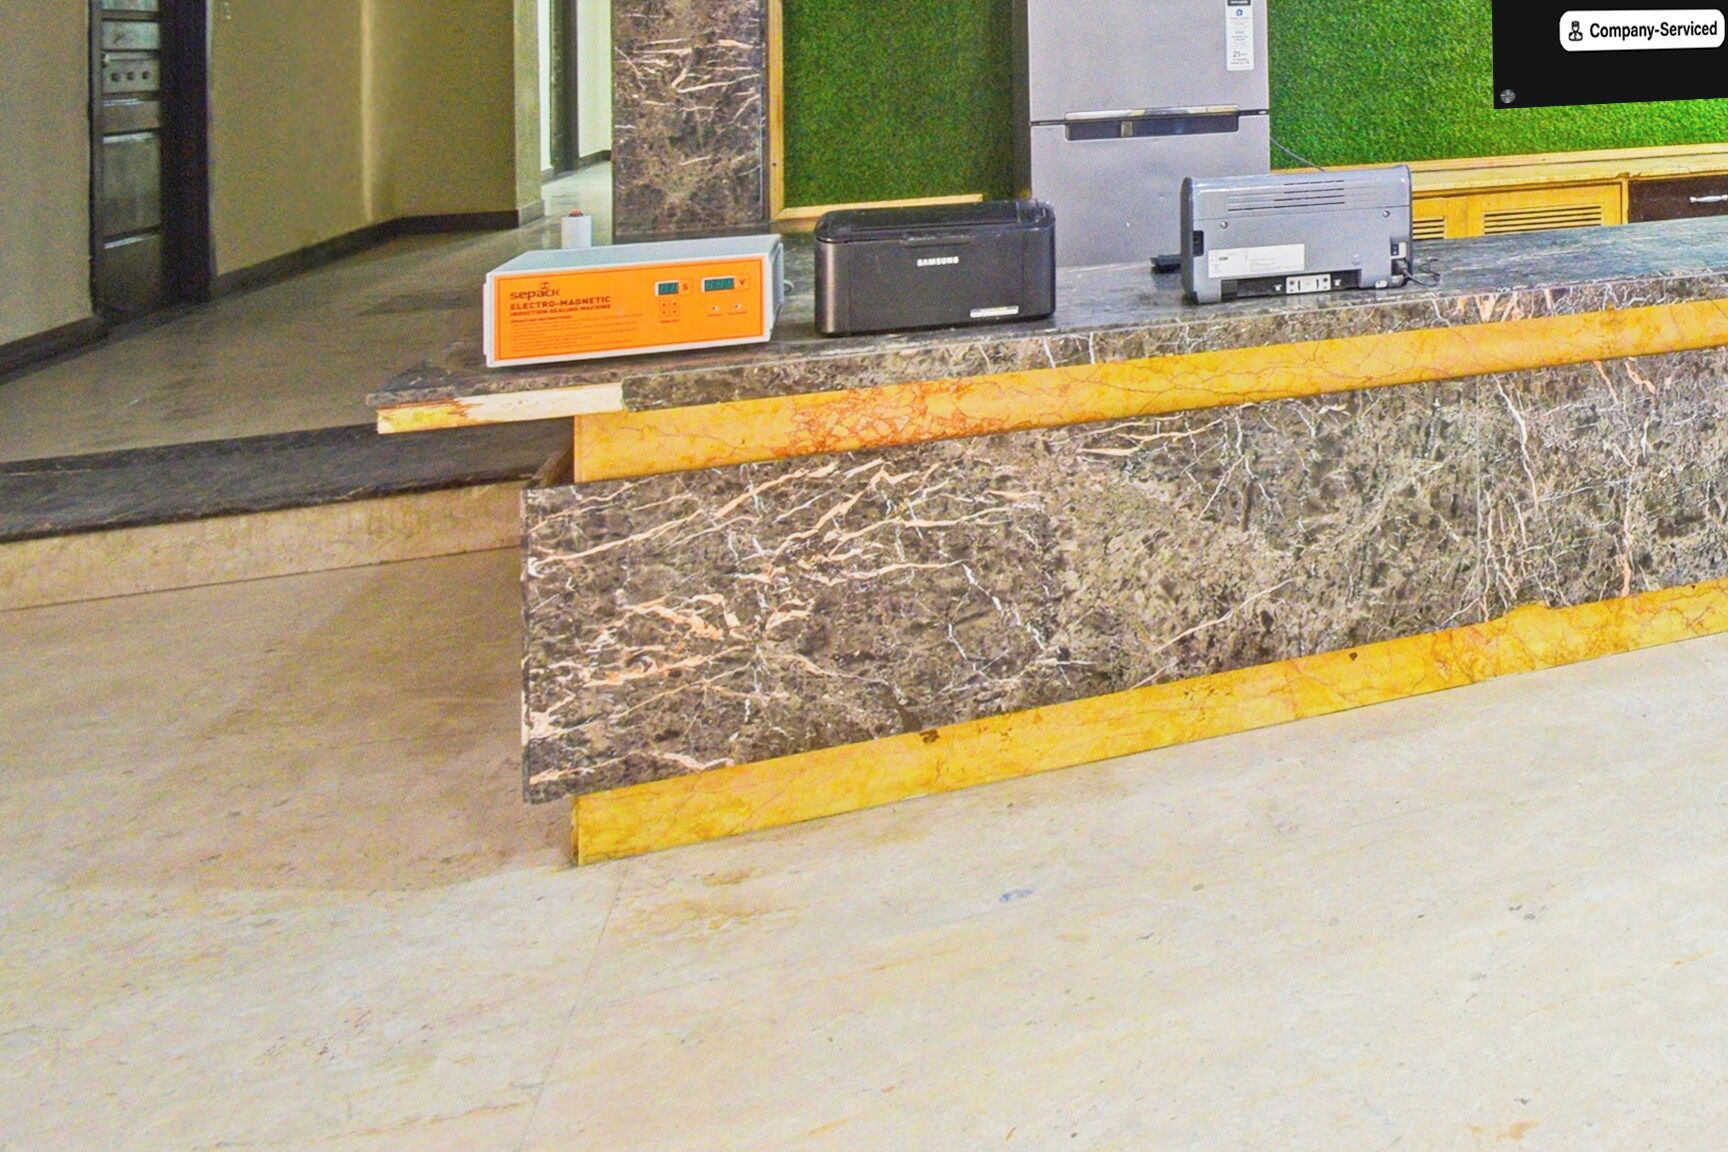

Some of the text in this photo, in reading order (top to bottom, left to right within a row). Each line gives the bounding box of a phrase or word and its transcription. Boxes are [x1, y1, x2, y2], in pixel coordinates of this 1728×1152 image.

[1589, 20, 1718, 41] Company-Serviced
[916, 256, 960, 267] SAMSUNG
[510, 289, 560, 301] sepack
[510, 296, 611, 310] ELECTRO-MAGNETIC
